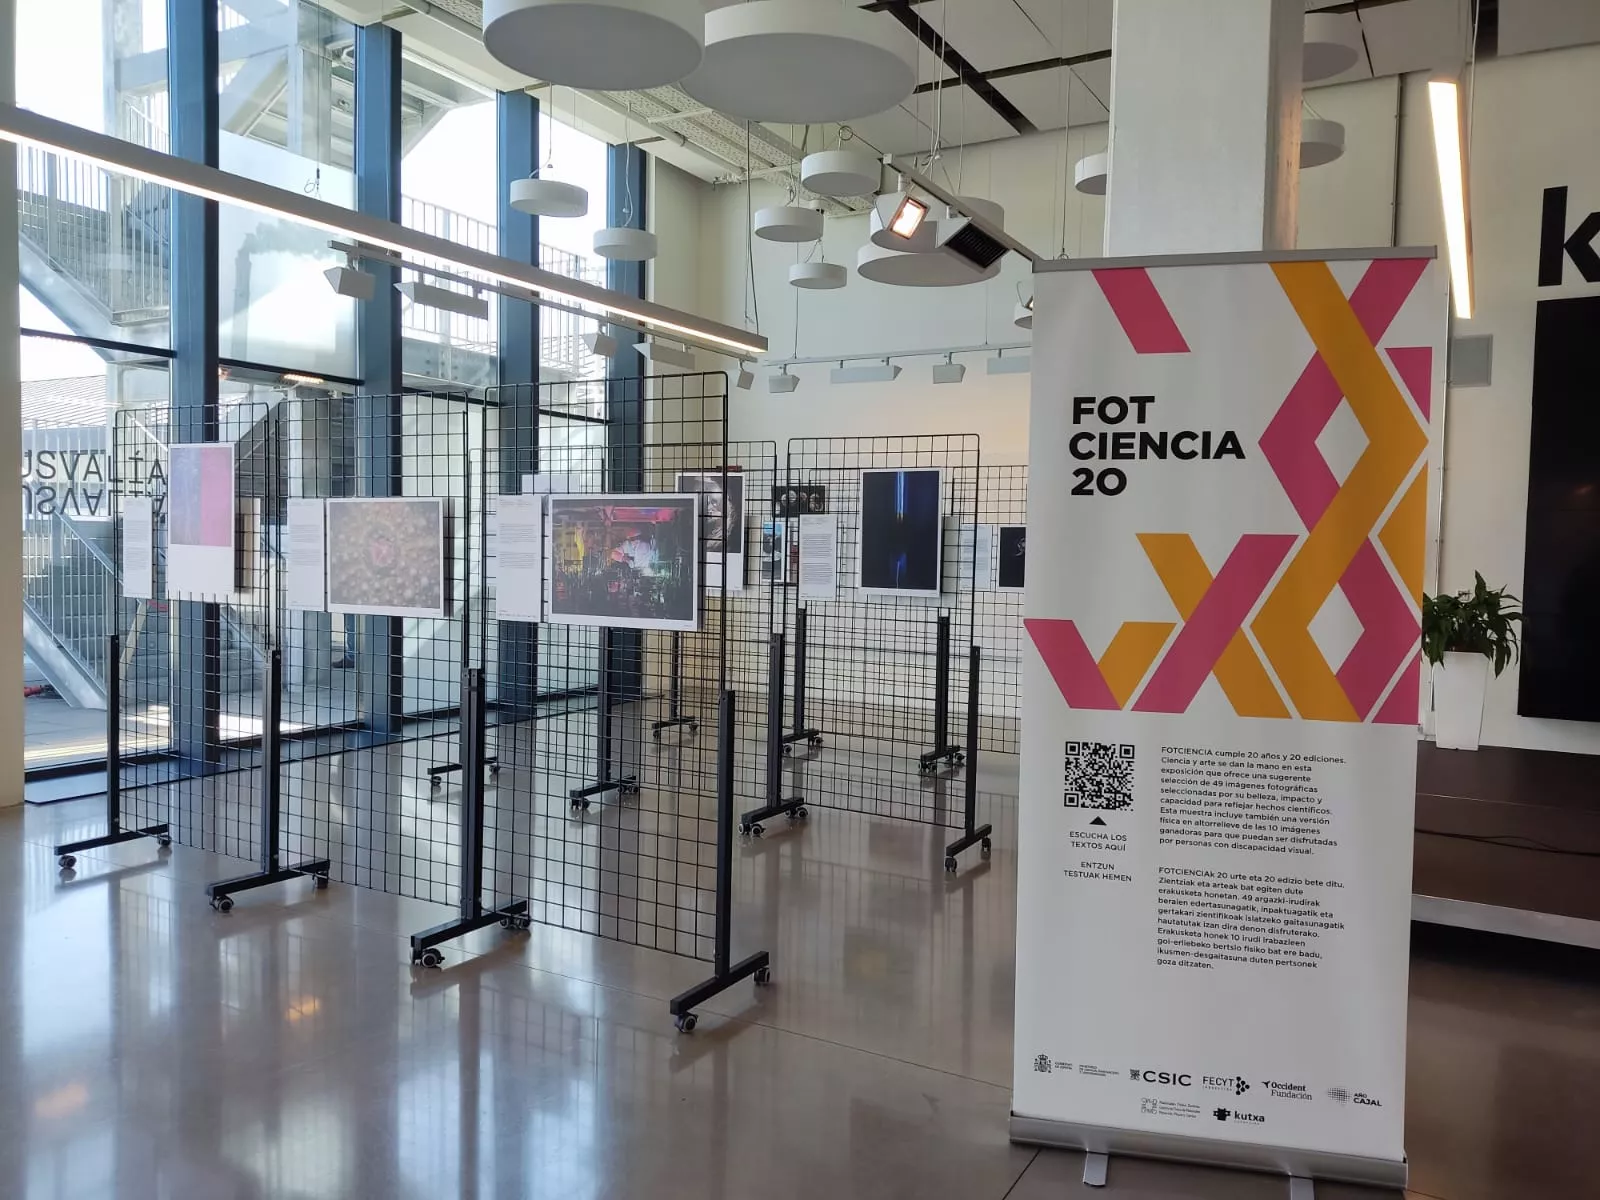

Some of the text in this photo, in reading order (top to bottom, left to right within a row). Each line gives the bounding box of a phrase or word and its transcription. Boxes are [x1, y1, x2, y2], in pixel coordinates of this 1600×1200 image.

[1538, 186, 1600, 287] k
[1073, 396, 1155, 425] FOT
[1069, 431, 1246, 460] CIENCIA
[1071, 468, 1127, 496] 20
[1247, 751, 1259, 759] 20
[1260, 752, 1281, 760] años
[1282, 754, 1288, 762] y
[1289, 753, 1301, 761] 20
[1161, 757, 1191, 765] Ciencia
[1192, 759, 1198, 767] y
[1246, 761, 1254, 769] la
[1205, 770, 1222, 778] que
[1223, 770, 1250, 779] ofrece
[1255, 803, 1285, 811] hechos
[1160, 806, 1178, 815] Esta
[1179, 809, 1212, 817] muestra
[1214, 810, 1243, 819] incluye
[1245, 813, 1280, 821] también
[1299, 817, 1330, 825] versión
[1160, 816, 1180, 825] física
[1242, 822, 1253, 830] de
[1255, 823, 1266, 831] las
[1268, 824, 1278, 832] 10
[1070, 831, 1127, 842] ESCUCHA LOS
[1072, 841, 1125, 852] TEXTOS AQUÍ
[1288, 846, 1314, 855] visual.
[1081, 861, 1114, 870] ENTZUN
[1064, 870, 1131, 882] TESTUAK HEMEN
[1217, 871, 1228, 879] 20
[1264, 875, 1276, 883] 20
[1277, 877, 1303, 885] edizio
[1305, 879, 1324, 887] bete
[1212, 882, 1238, 890] arteak
[1240, 883, 1254, 891] bat
[1256, 885, 1283, 894] egiten
[1284, 887, 1304, 895] dute
[1158, 897, 1188, 906] beraien
[1320, 911, 1333, 919] eta
[1203, 921, 1220, 929] izan
[1221, 923, 1238, 931] dira
[1239, 924, 1266, 933] denon
[1203, 931, 1229, 940] honek
[1231, 933, 1240, 941] 10
[1242, 934, 1261, 943] irudi
[1213, 942, 1242, 951] bertsio
[1267, 947, 1281, 955] bat
[1157, 958, 1177, 966] goza
[1249, 956, 1274, 964] duten
[1143, 1071, 1192, 1086] CSIC
[1203, 1076, 1234, 1087] FECYT
[1271, 1081, 1306, 1092] Occident
[1271, 1089, 1313, 1100] Fundación
[1353, 1097, 1383, 1107] CAJAL
[1234, 1111, 1265, 1122] kutxa
